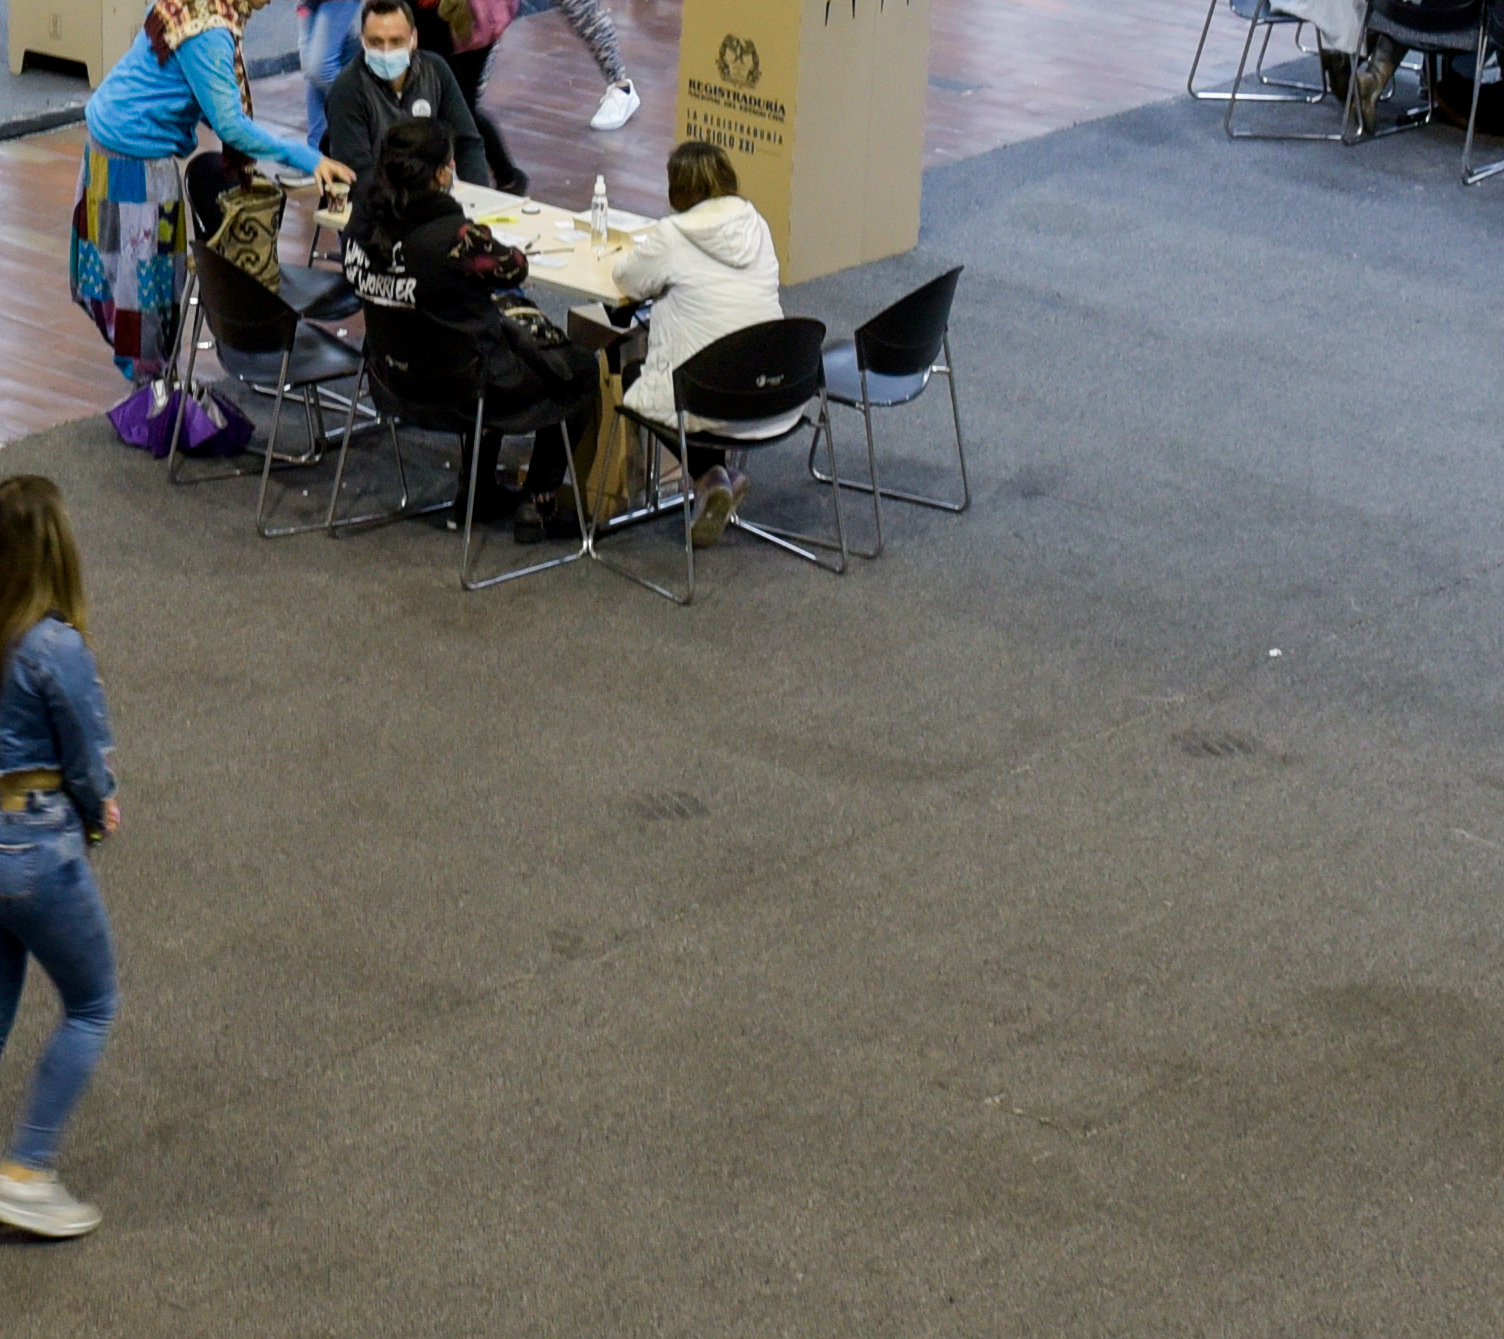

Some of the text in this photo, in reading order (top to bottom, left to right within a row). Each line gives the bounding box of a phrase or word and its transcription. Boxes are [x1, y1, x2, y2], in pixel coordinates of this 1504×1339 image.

[688, 78, 787, 116] REGISTRADURÍA
[686, 121, 755, 156] DEL SIGLO XXI
